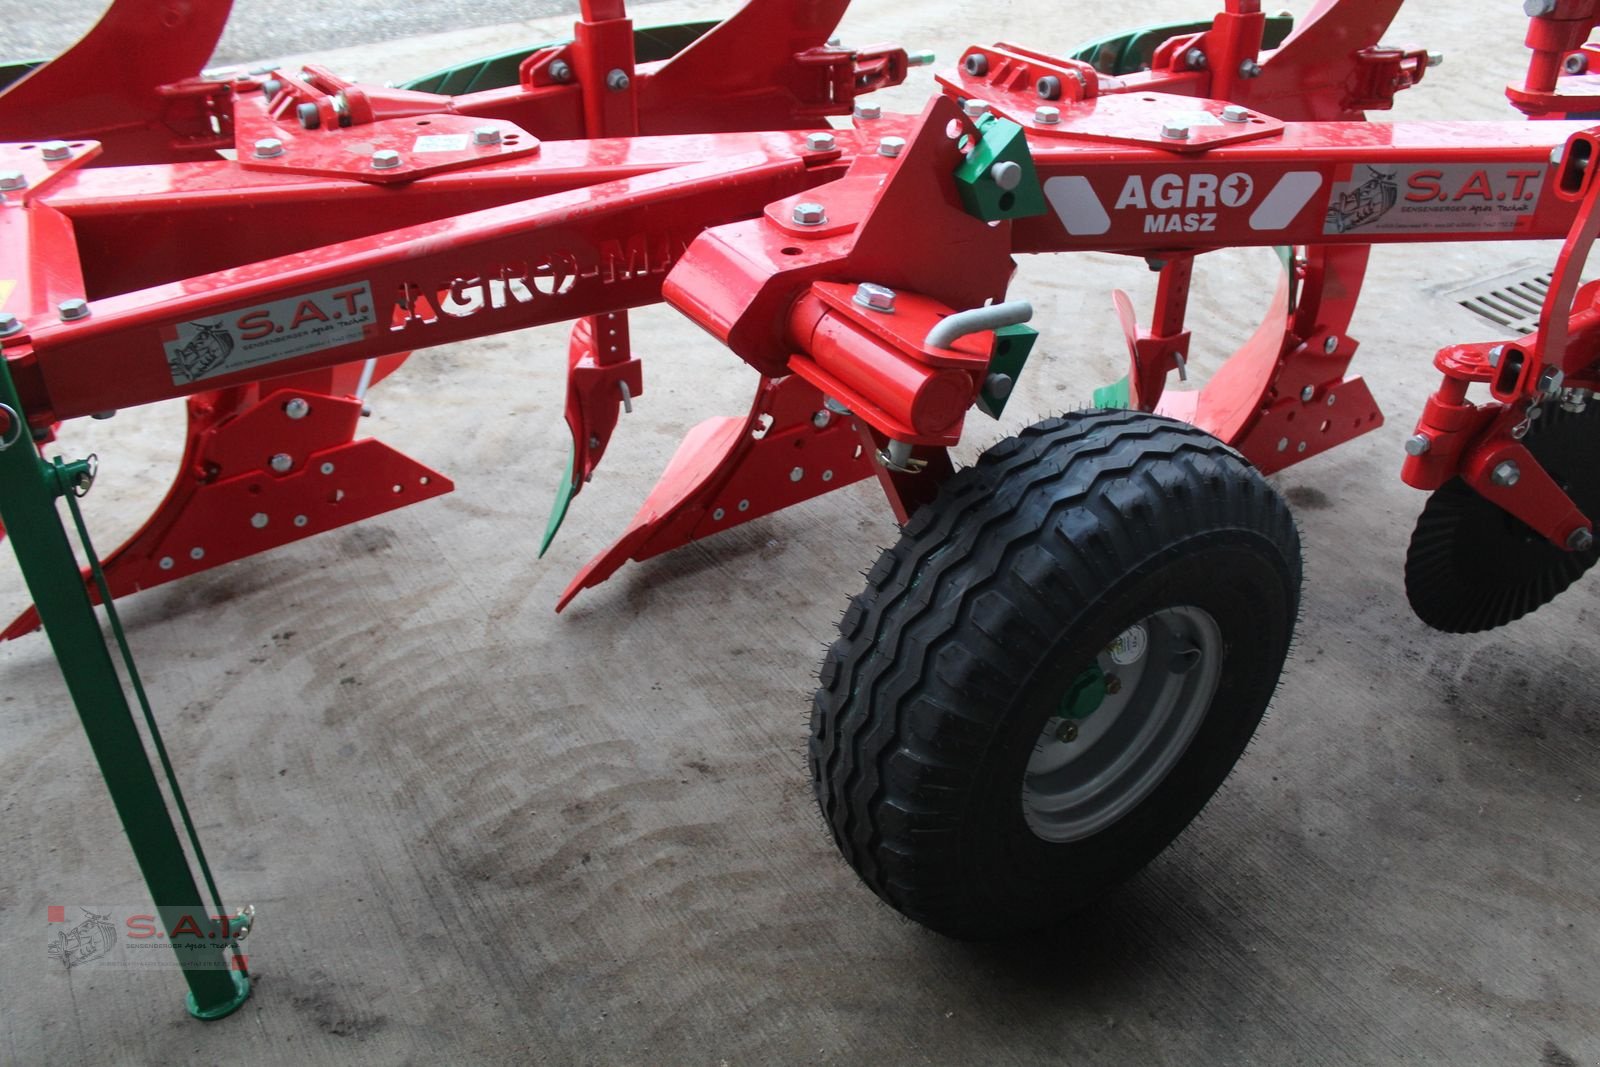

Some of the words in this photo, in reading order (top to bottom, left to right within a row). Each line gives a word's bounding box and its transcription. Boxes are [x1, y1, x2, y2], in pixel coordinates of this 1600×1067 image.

[1114, 172, 1254, 209] AGRO
[1404, 169, 1541, 202] S.A.T.
[1143, 213, 1218, 233] MASZ
[236, 287, 369, 341] S.A.T.
